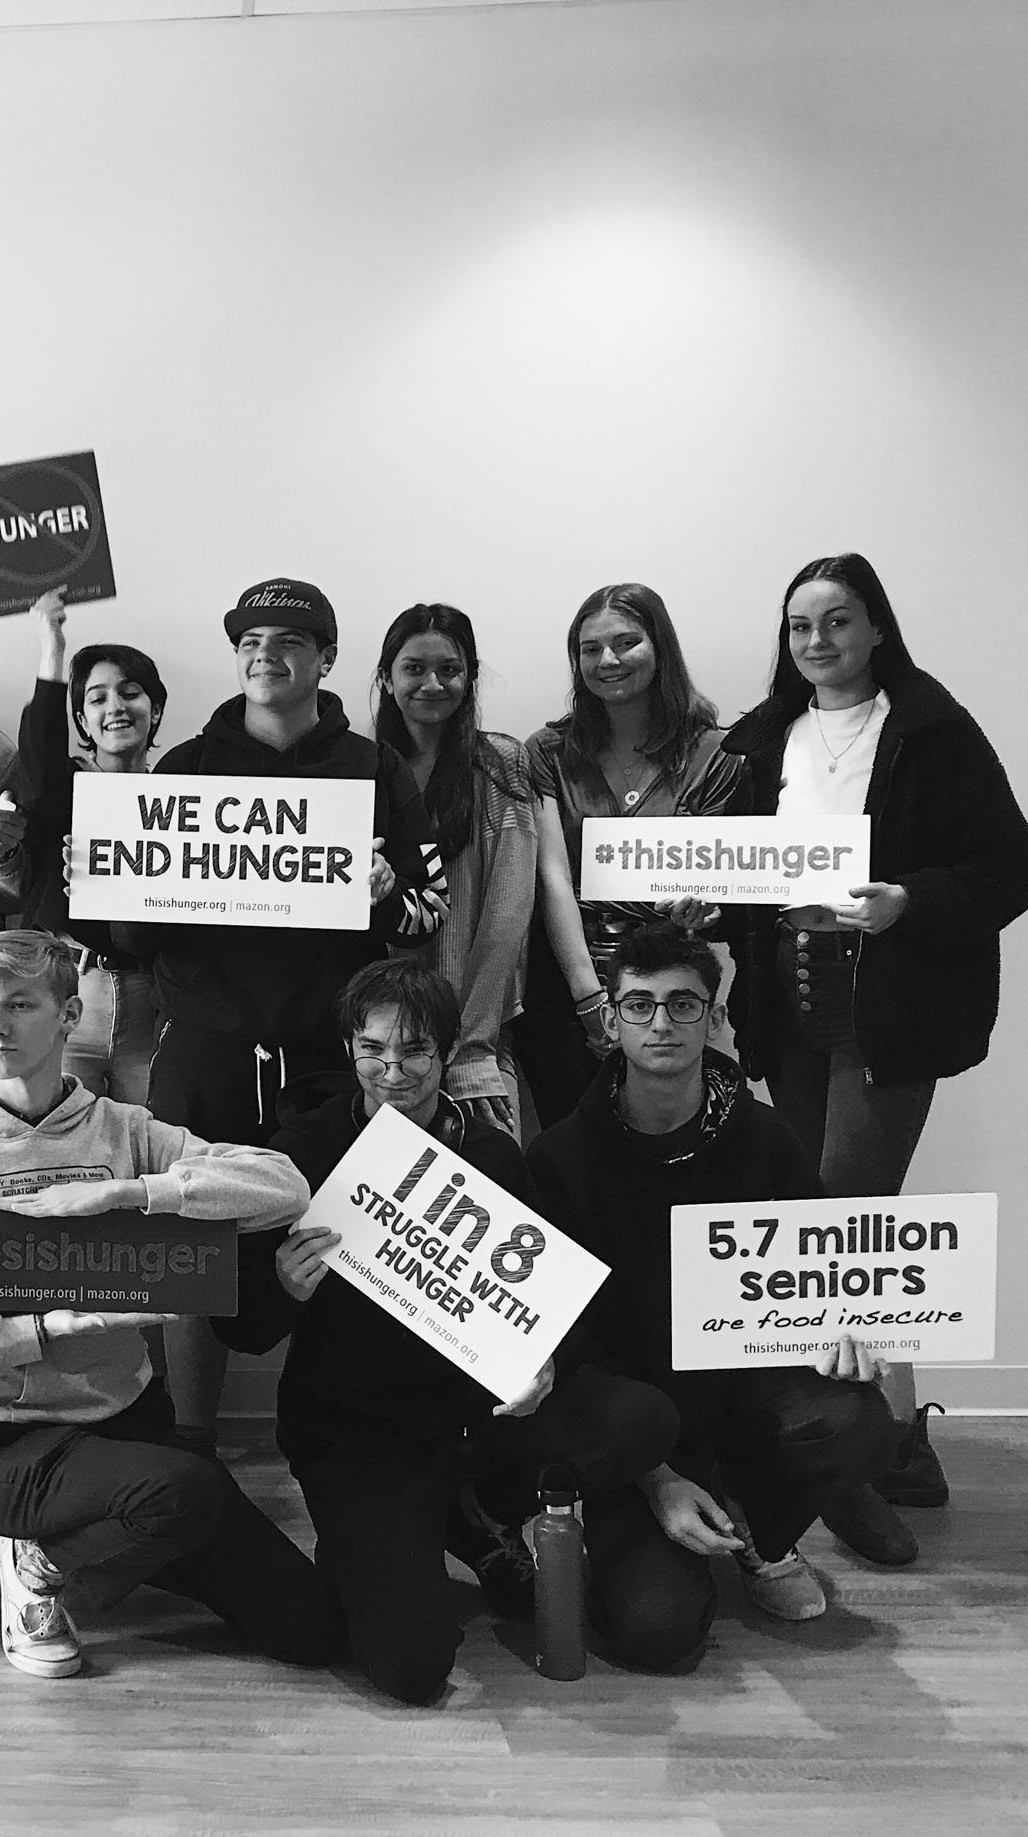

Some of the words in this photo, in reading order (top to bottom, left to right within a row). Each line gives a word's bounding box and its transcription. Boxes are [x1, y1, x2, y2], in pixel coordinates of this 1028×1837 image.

[137, 794, 201, 833] WE
[215, 797, 307, 835] CAN
[88, 839, 171, 877] END
[181, 842, 353, 885] HUNGER
[595, 838, 853, 879] #thisishunger
[144, 897, 226, 913] thisishunger.org
[236, 901, 291, 915] mazon.org
[650, 882, 728, 895] thisishunger.org
[737, 884, 790, 896] mazon.org
[422, 1172, 491, 1253] in
[490, 1223, 546, 1284] 8
[709, 1219, 779, 1260] 5.7
[799, 1214, 958, 1255] million
[350, 1183, 469, 1281] STRUGGLE
[469, 1271, 541, 1335] WITH
[87, 1287, 149, 1303] mazon.org
[375, 1238, 475, 1323] HUNGER
[740, 1261, 926, 1301] seniors
[338, 1249, 419, 1317] thisishunger.org
[424, 1316, 479, 1364] mazon.org
[702, 1317, 745, 1332] are
[758, 1309, 827, 1330] food
[839, 1308, 964, 1327] insecure
[866, 1339, 921, 1351] azon.org
